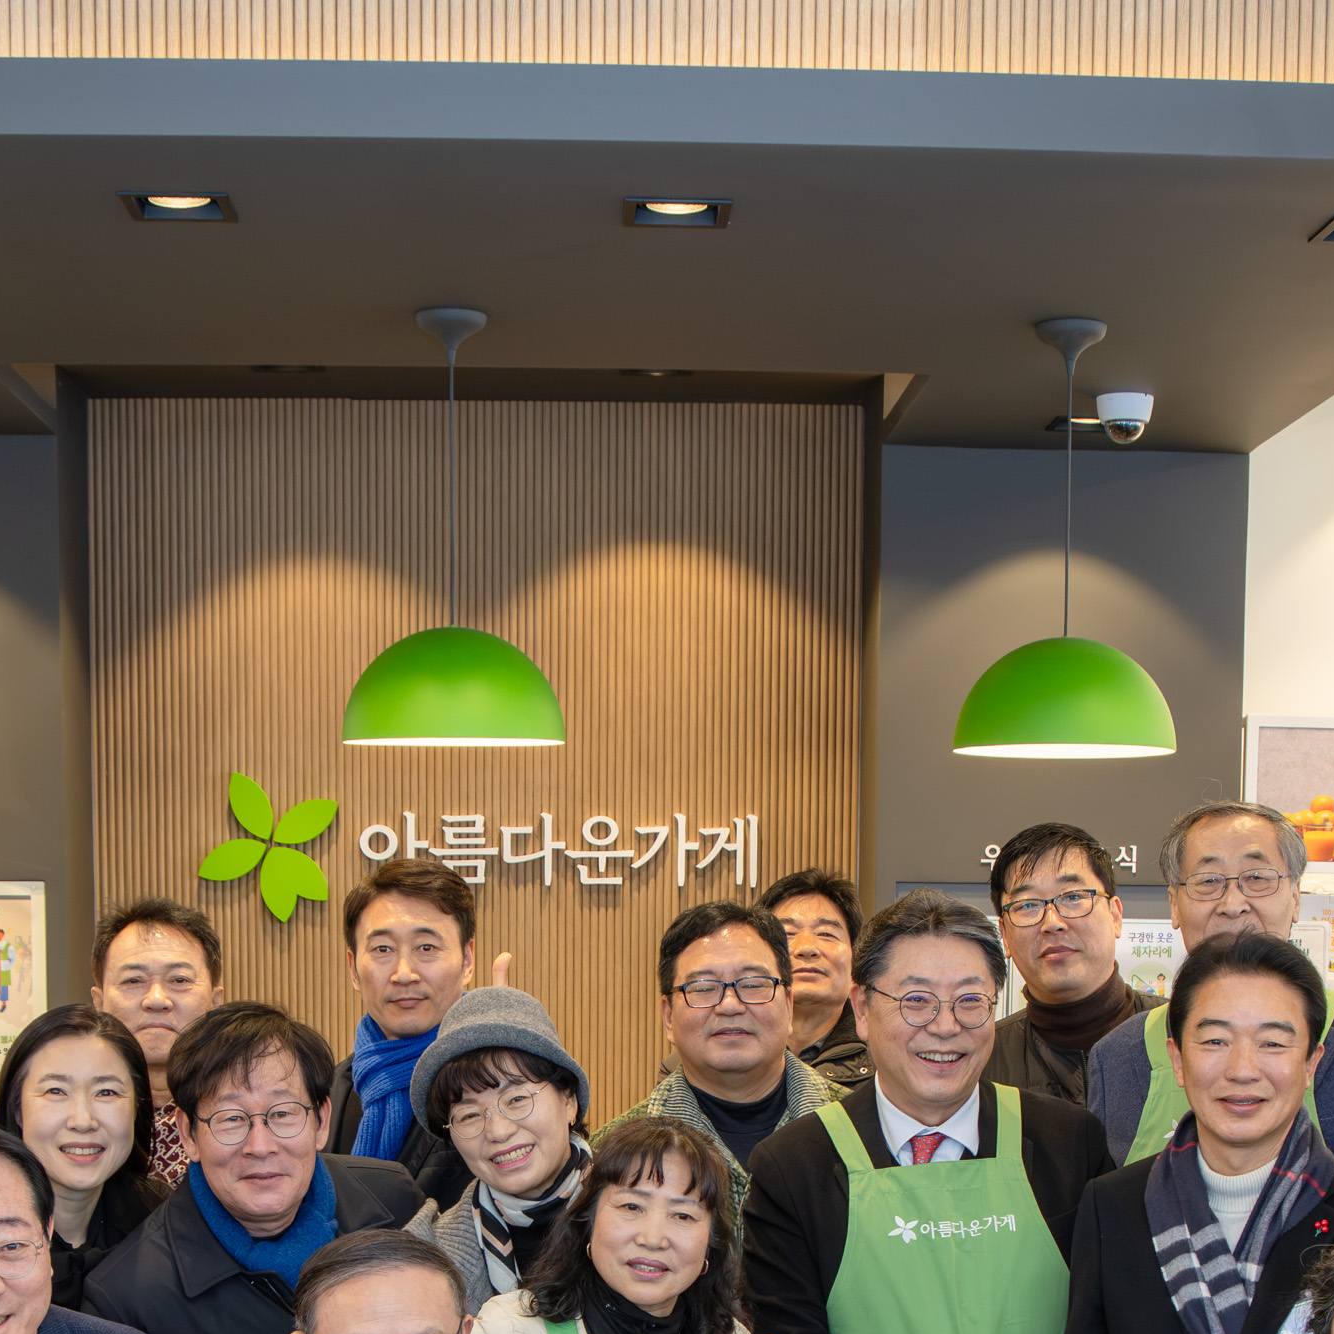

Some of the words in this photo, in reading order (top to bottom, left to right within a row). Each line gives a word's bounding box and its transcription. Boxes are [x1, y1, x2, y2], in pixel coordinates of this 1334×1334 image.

[359, 811, 759, 888] 아름다운가게
[1128, 932, 1154, 943] 구경한
[1156, 932, 1174, 943] 옷은
[1131, 945, 1173, 959] 제자리에
[920, 1214, 1017, 1239] 아름다운가게
